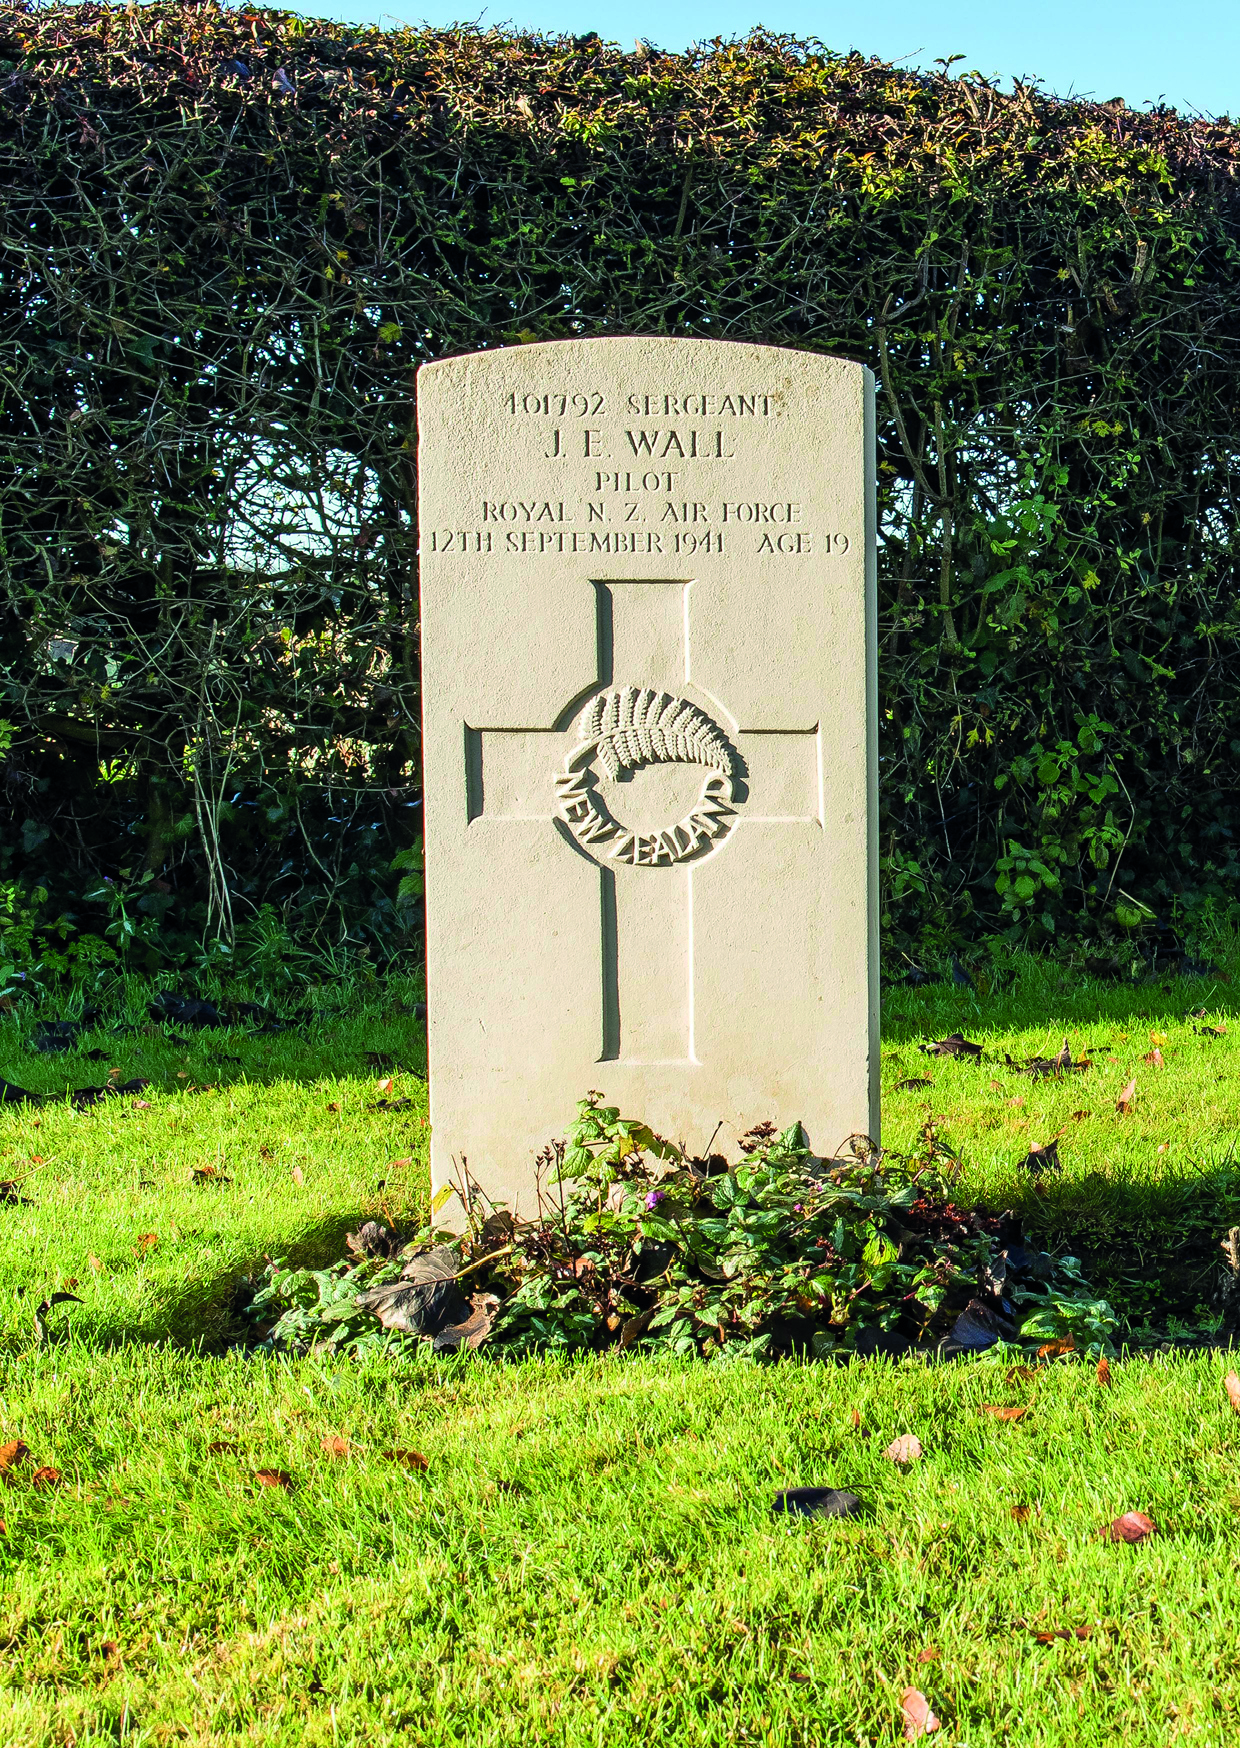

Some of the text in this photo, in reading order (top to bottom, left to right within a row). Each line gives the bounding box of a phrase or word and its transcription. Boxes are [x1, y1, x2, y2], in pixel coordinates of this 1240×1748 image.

[501, 392, 774, 416] 401792 SERGEANT
[545, 430, 735, 458] J. E. WALL
[595, 471, 680, 492] PILOT
[483, 502, 802, 522] ROYAL N. Z. AIR FORCE
[431, 531, 851, 555] 12TH SEPTEMBER 1941 AGE 19
[553, 767, 739, 866] NEW ZEALAND
